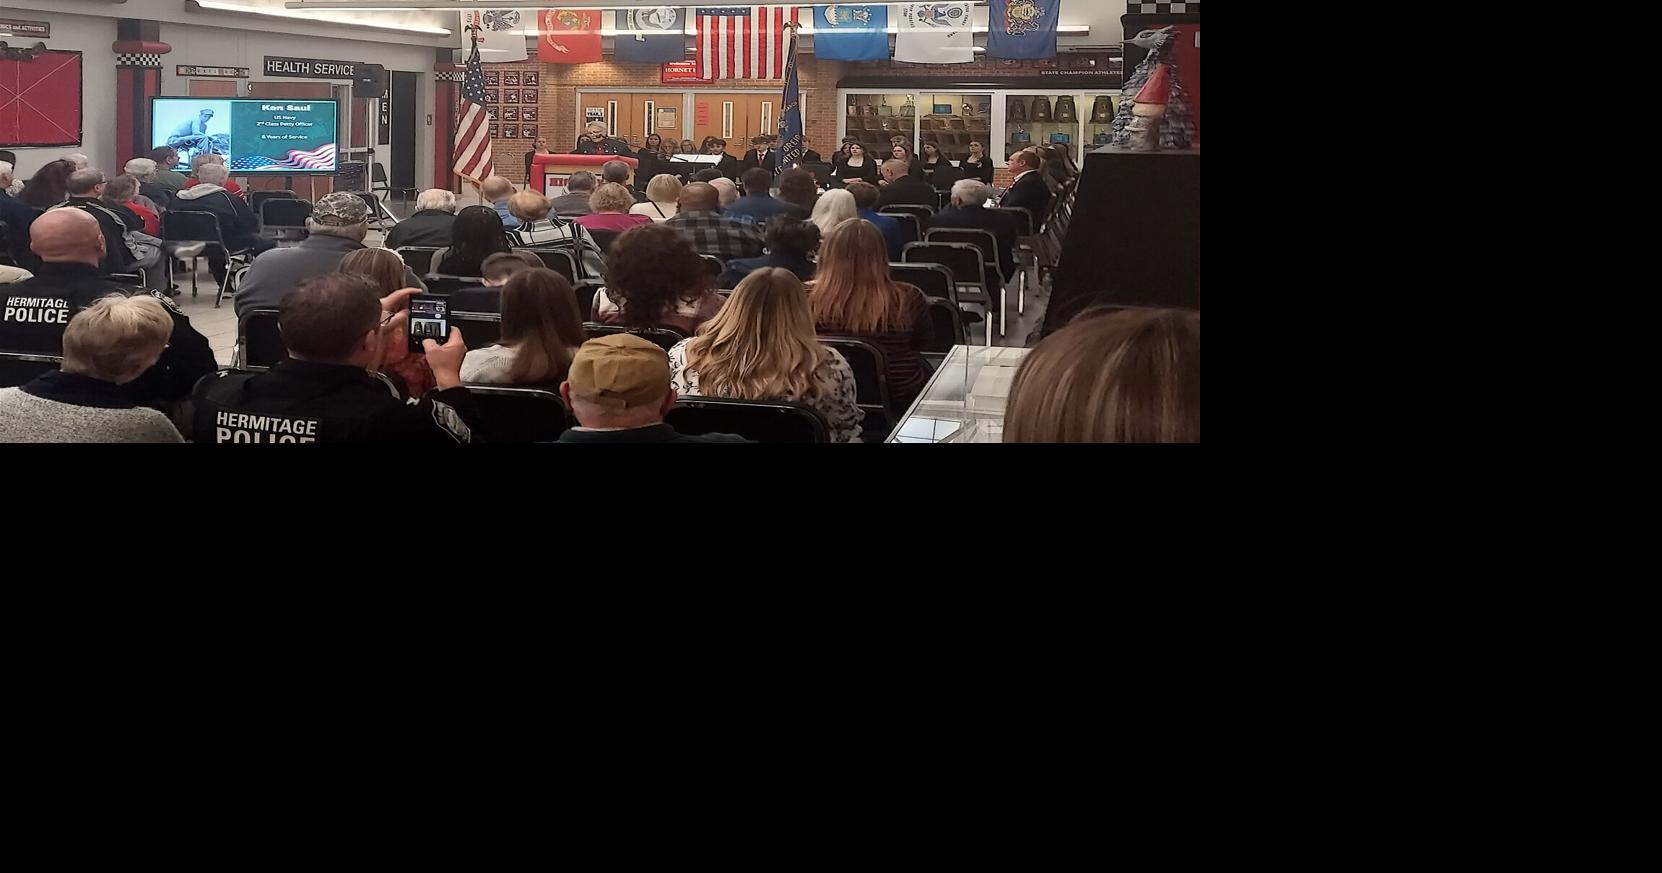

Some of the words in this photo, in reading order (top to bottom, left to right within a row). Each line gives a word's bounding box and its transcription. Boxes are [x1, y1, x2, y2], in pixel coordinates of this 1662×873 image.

[267, 61, 310, 74] HEALTH
[314, 63, 354, 76] SERVICE
[4, 308, 69, 324] POLICE
[217, 411, 318, 435] HERMITAGE
